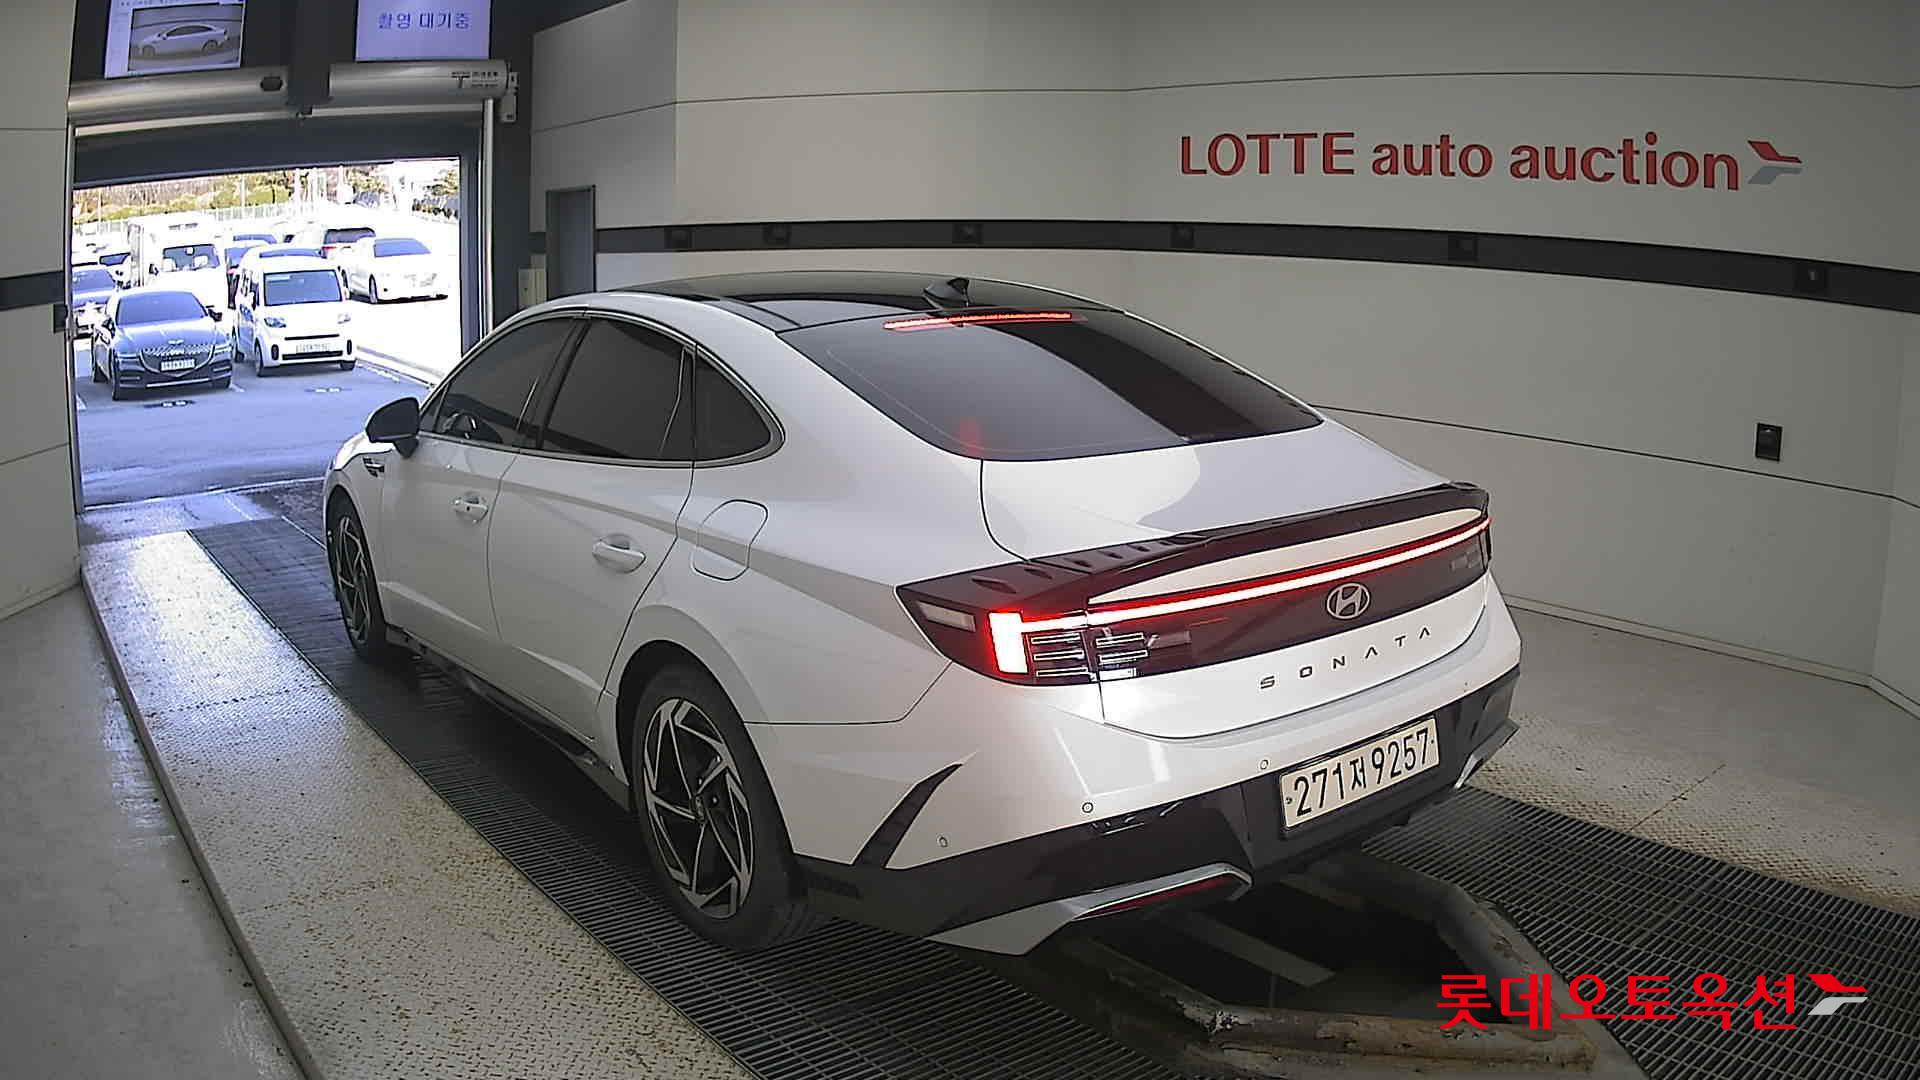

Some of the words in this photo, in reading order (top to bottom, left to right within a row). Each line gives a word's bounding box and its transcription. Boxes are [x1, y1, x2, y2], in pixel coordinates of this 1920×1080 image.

[1180, 132, 1355, 176] LOTTE
[1371, 134, 1493, 178] auto
[1509, 131, 1739, 191] auction
